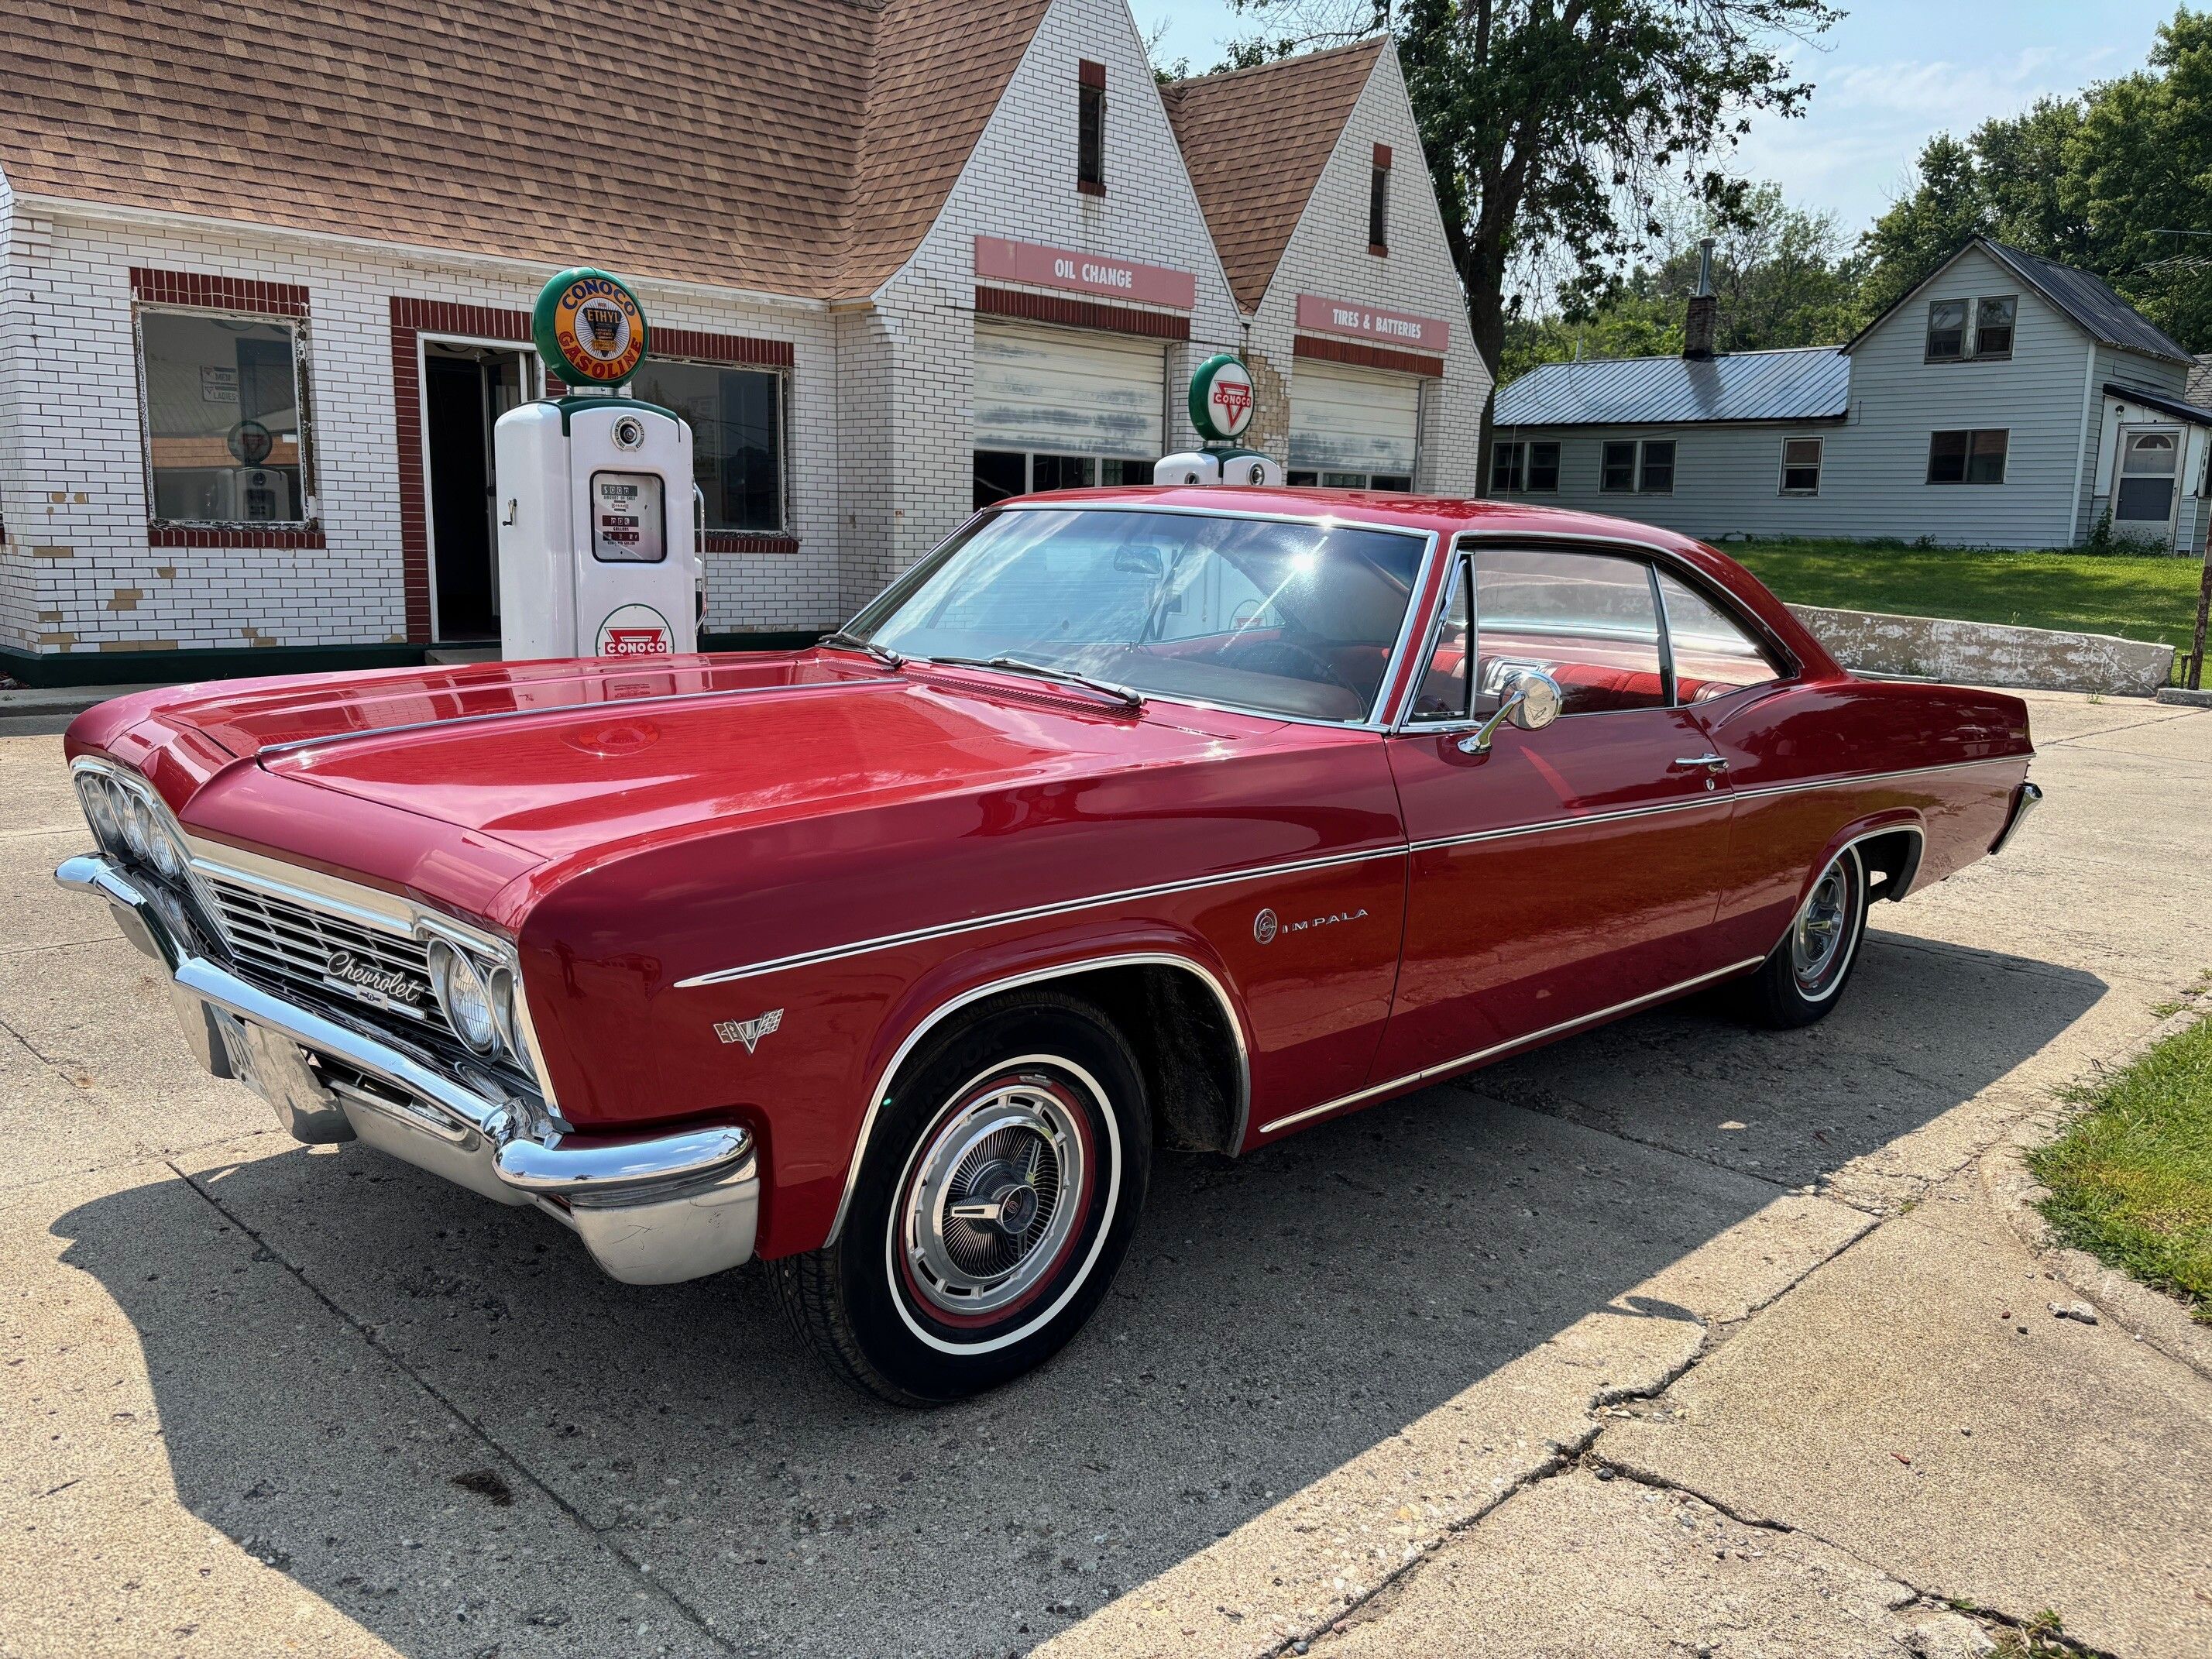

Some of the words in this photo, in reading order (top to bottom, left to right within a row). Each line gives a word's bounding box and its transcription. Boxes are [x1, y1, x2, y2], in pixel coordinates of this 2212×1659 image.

[1054, 258, 1076, 280] OIL
[1081, 263, 1132, 288] CHANGE
[562, 279, 636, 317] CONOCO
[587, 310, 620, 324] ETHYL
[1332, 308, 1359, 328] TIRES
[1363, 314, 1370, 330] &
[1376, 316, 1421, 338] BATTERIES
[558, 331, 642, 379] GASOLINE
[1214, 393, 1251, 407] CONOCO
[606, 642, 666, 654] CONOCO
[1282, 908, 1369, 934] IMPALA
[327, 950, 426, 1001] Chevrolet
